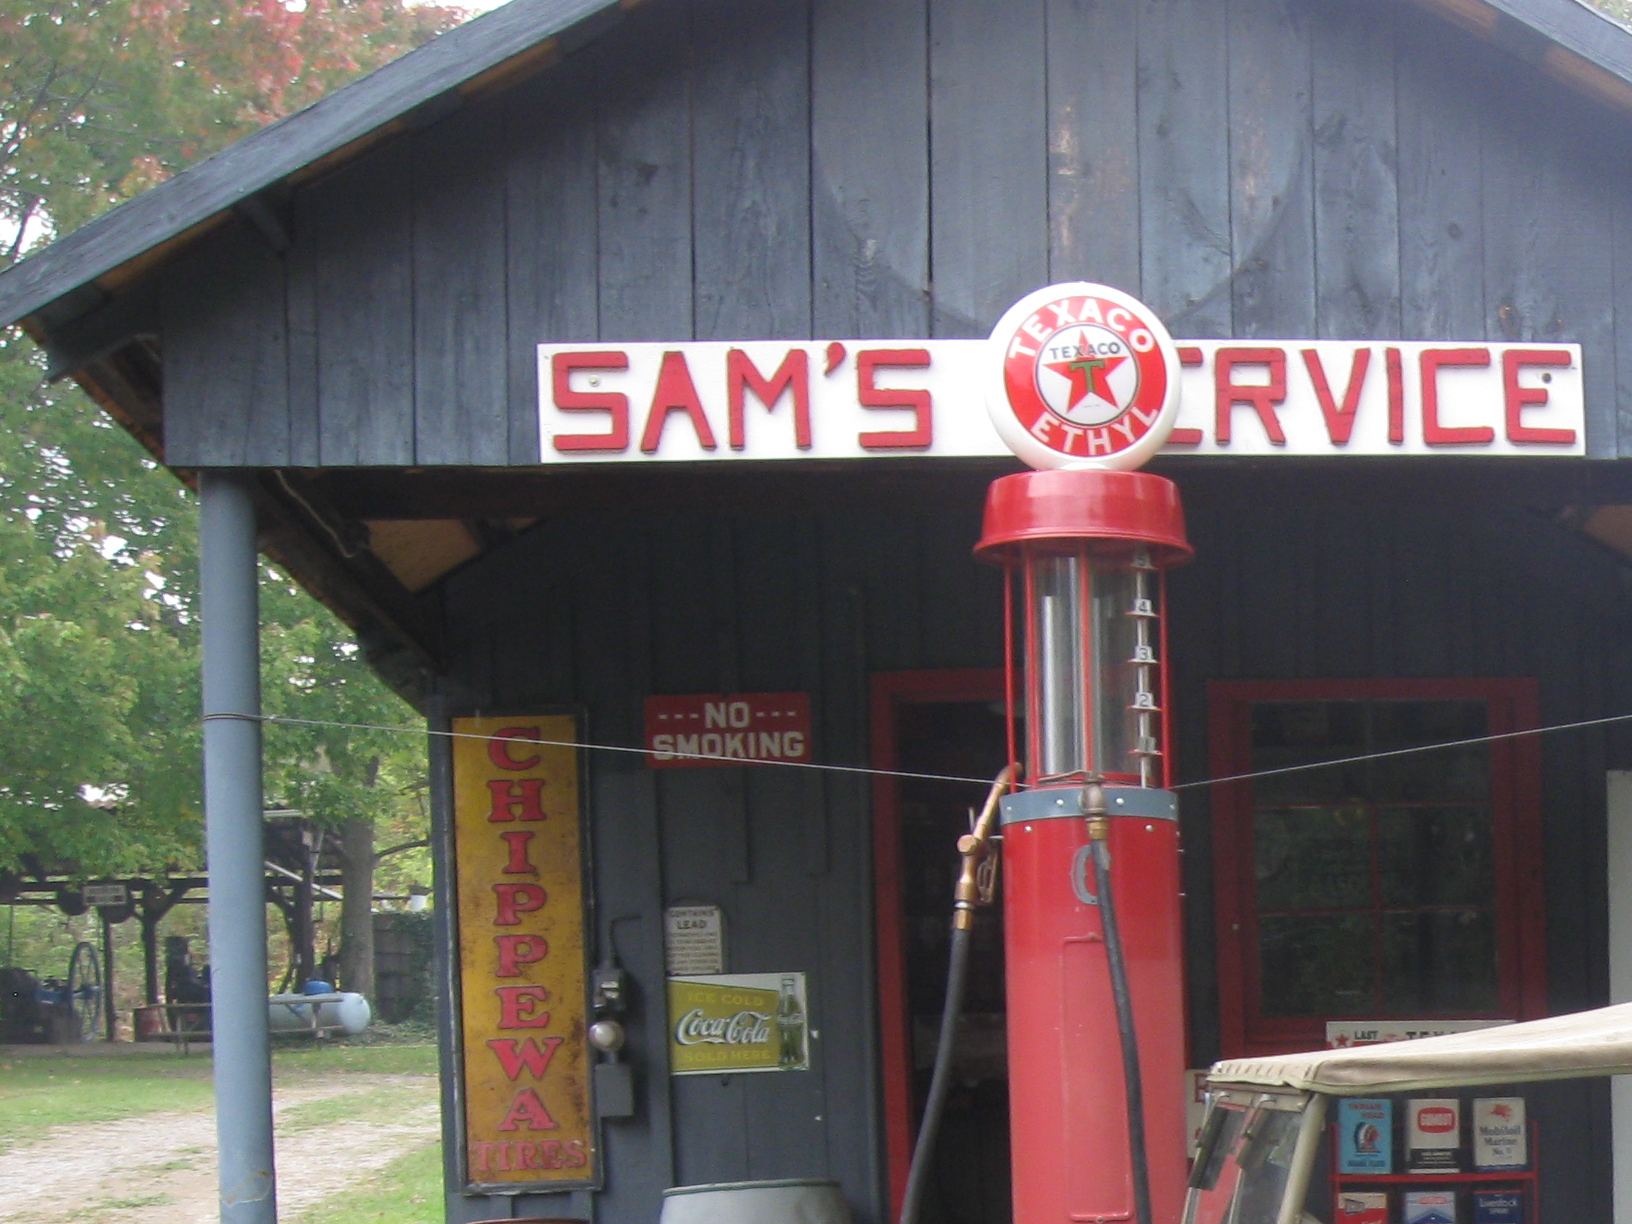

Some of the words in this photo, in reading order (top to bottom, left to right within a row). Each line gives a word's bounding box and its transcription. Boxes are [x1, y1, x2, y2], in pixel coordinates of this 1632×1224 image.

[1008, 298, 1155, 358] TEXACO
[1050, 341, 1121, 360] TEXACO
[551, 342, 933, 452] SAM'S
[1031, 407, 1158, 456] ETHYL
[704, 701, 749, 728] NO
[652, 731, 805, 760] SMOKING
[486, 726, 564, 1131] CHIPPEWA
[677, 919, 707, 930] LEAD
[473, 1139, 587, 1172] TIRES
